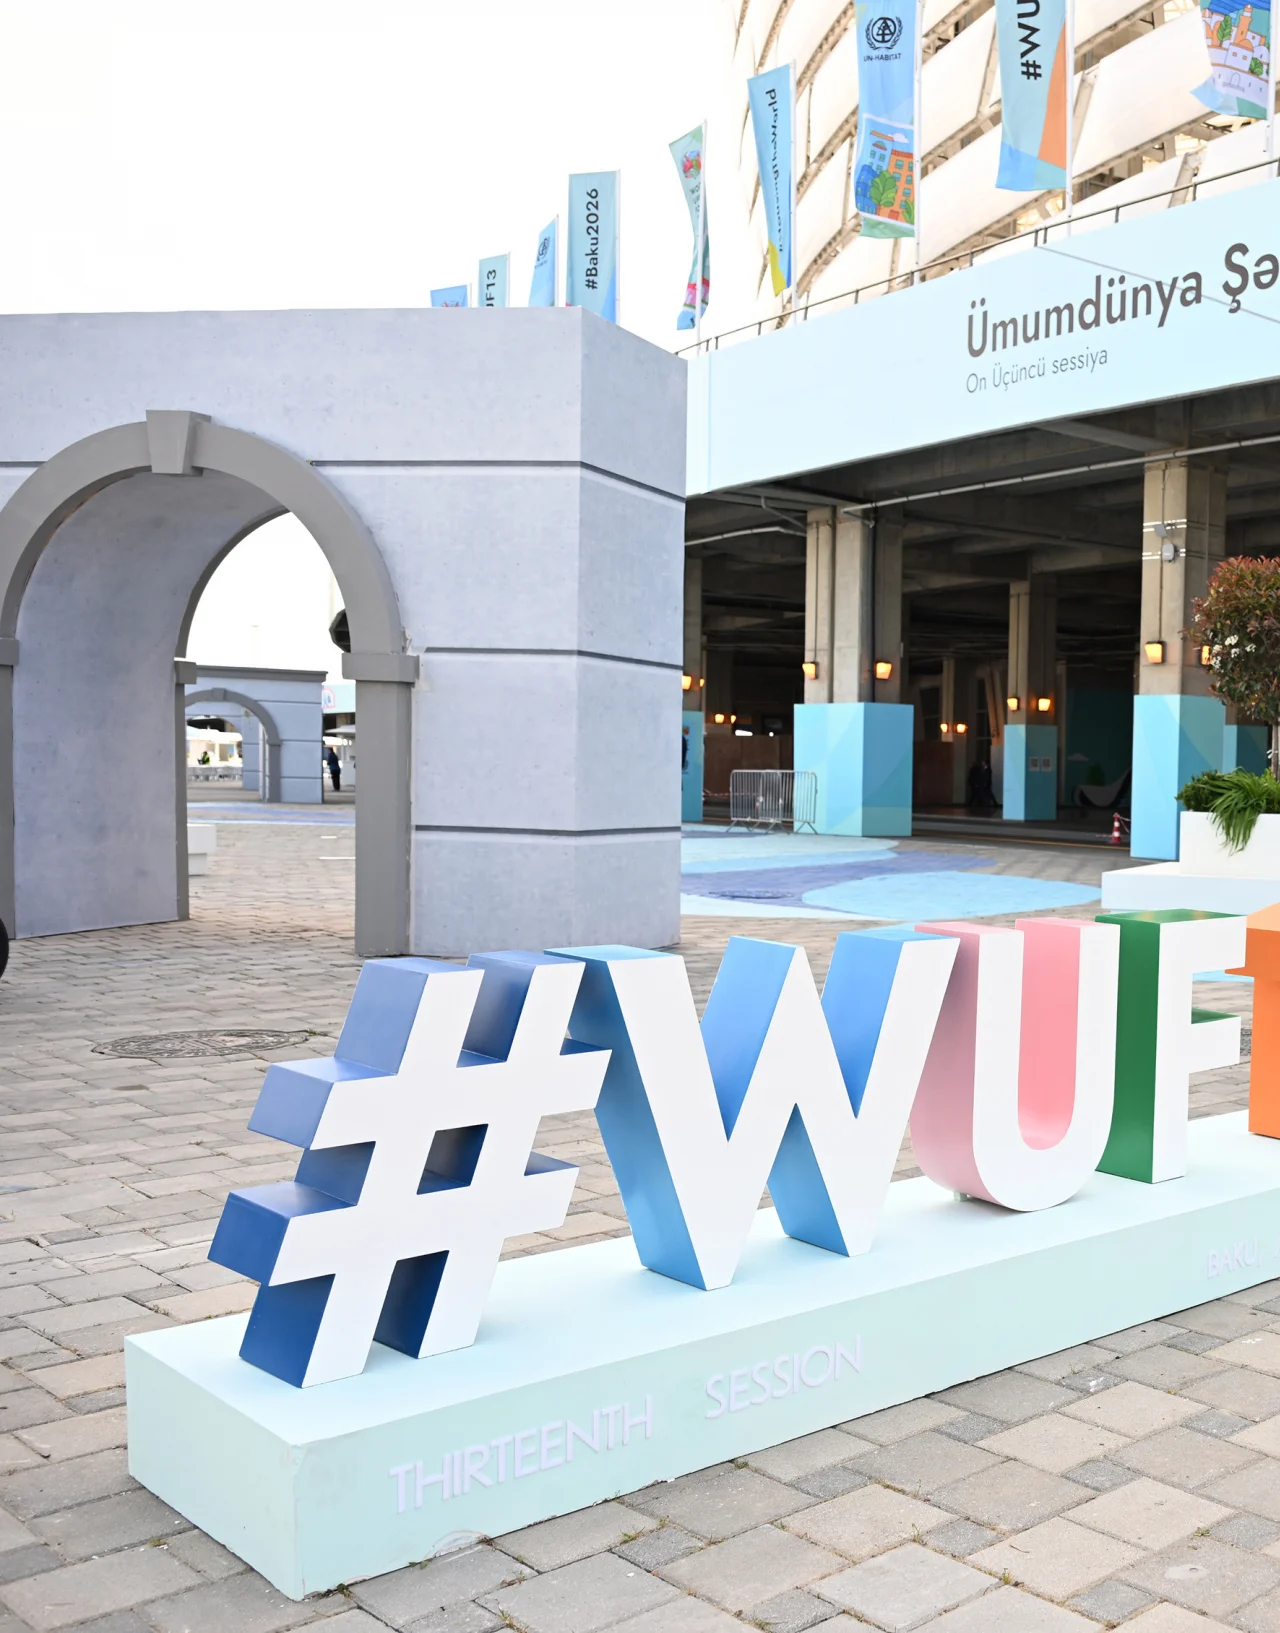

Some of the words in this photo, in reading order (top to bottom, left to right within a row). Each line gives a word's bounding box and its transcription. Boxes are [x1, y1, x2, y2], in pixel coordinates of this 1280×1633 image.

[863, 52, 902, 62] UN-HABITAT
[585, 188, 600, 290] #Baku2026
[967, 270, 1203, 358] Ümumdünya
[966, 373, 987, 394] On
[992, 362, 1046, 391] Üçüncü
[1051, 346, 1108, 374] sessiya
[389, 1394, 653, 1514] THIRTEENTH
[704, 1333, 862, 1419] SESSION
